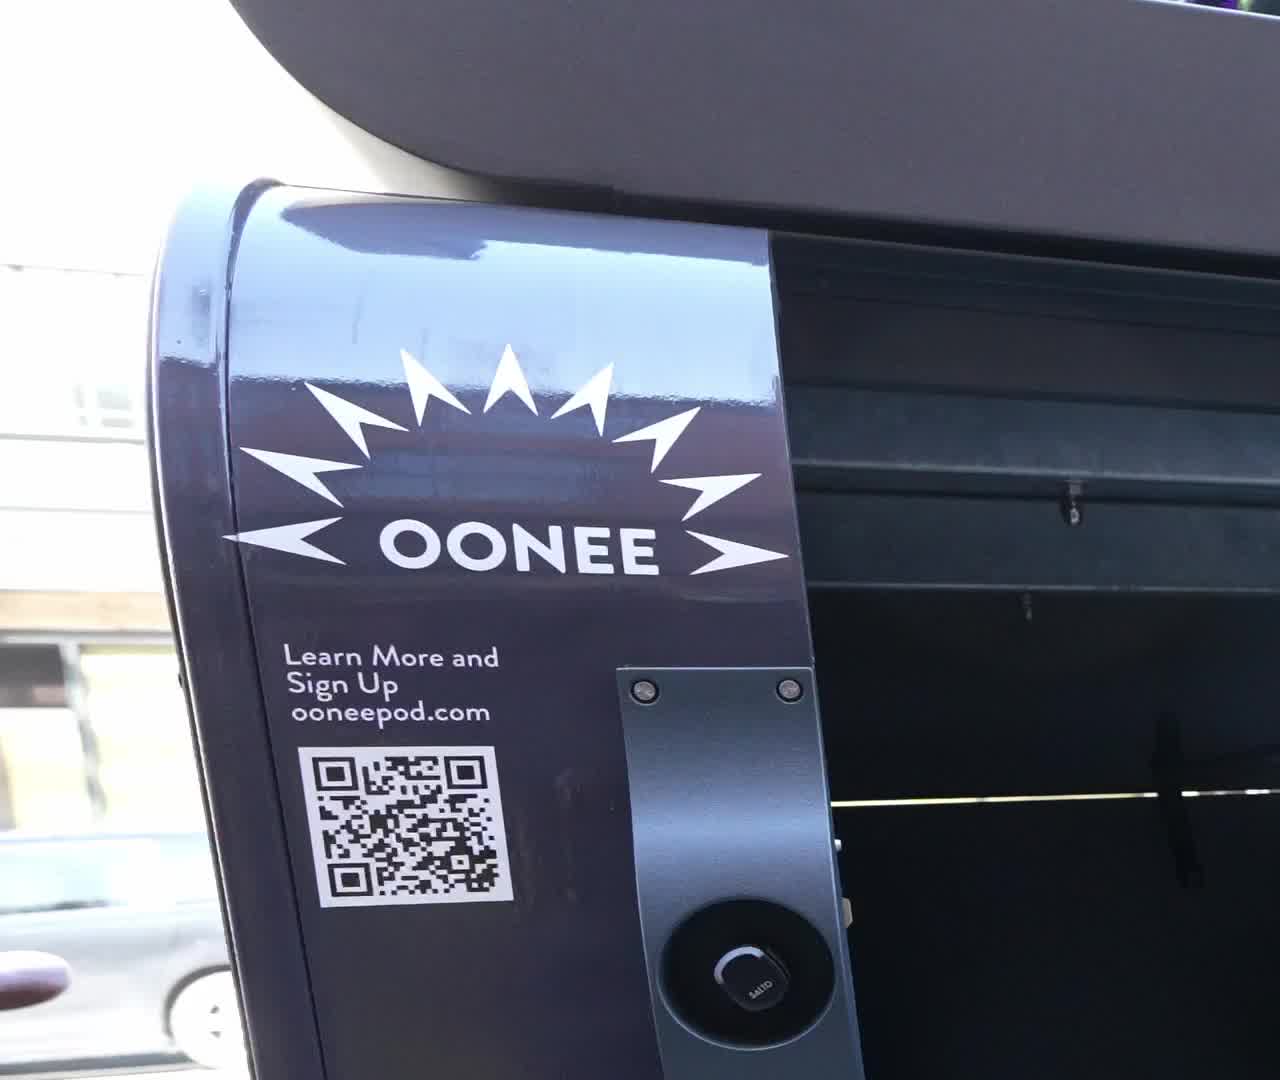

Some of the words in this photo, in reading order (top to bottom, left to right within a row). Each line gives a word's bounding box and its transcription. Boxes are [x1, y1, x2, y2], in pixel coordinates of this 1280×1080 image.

[379, 518, 660, 576] OONEE
[283, 643, 363, 667] Learn
[372, 644, 444, 667] More
[452, 646, 500, 668] and
[286, 671, 349, 702] Sign
[357, 671, 399, 702] Up
[291, 700, 490, 729] ooneepod.com
